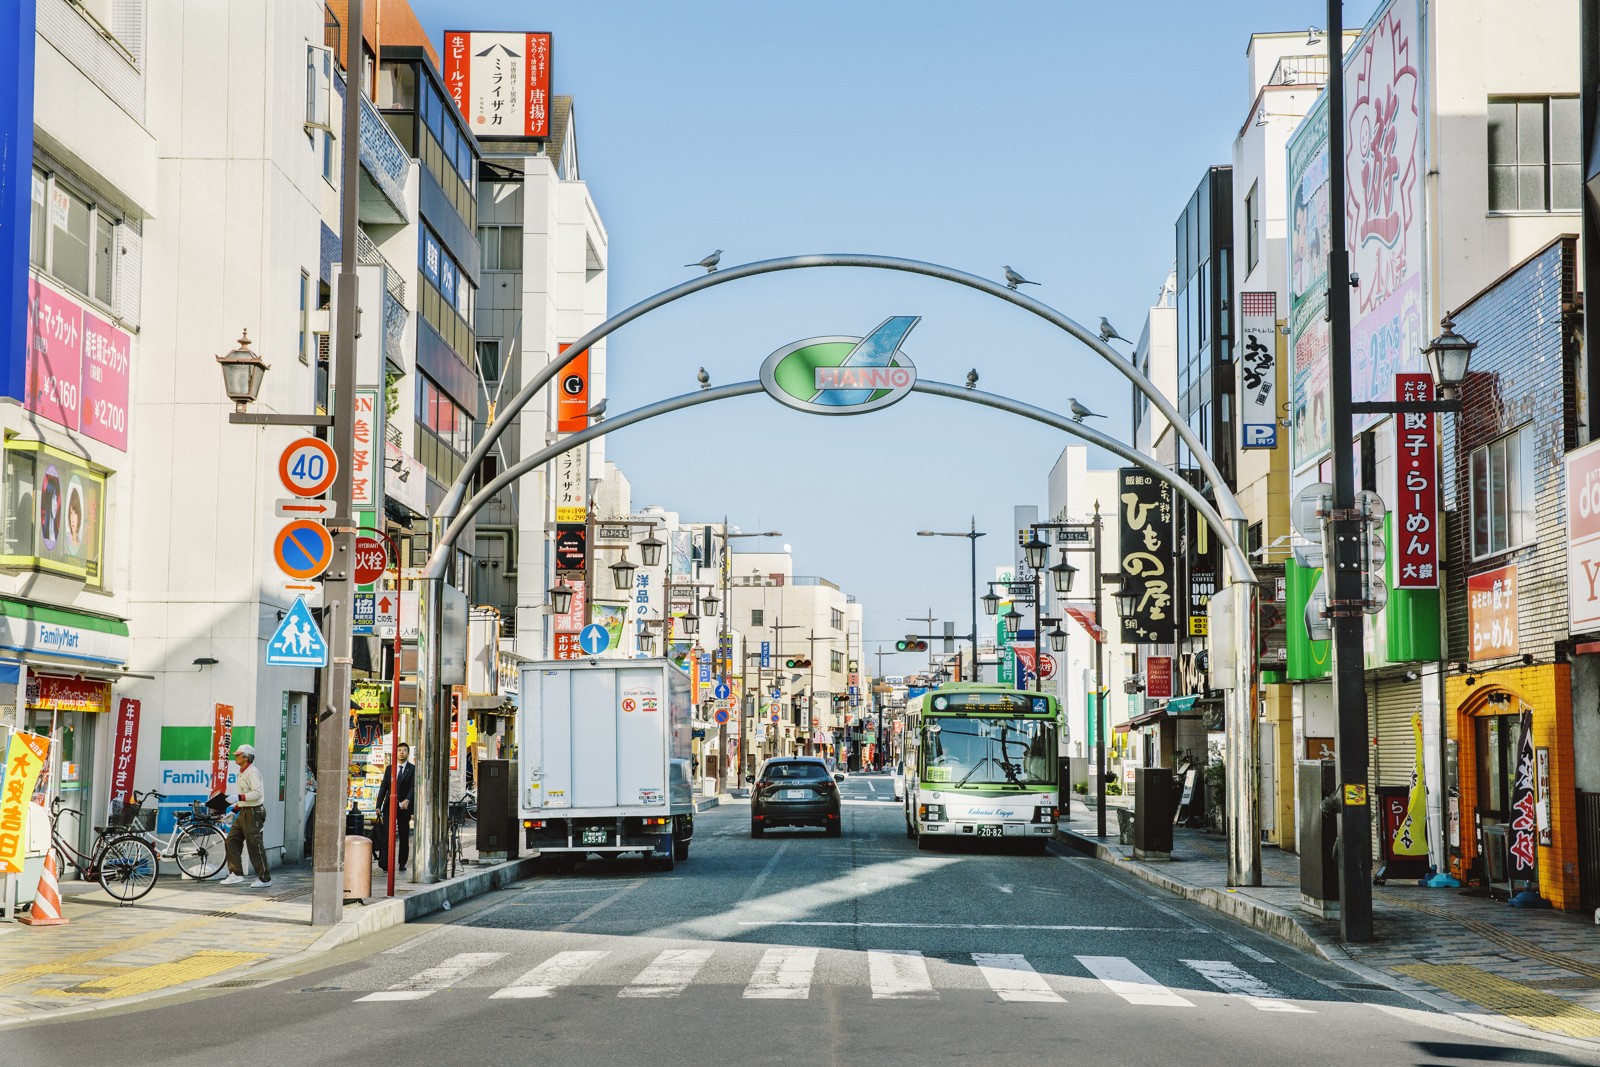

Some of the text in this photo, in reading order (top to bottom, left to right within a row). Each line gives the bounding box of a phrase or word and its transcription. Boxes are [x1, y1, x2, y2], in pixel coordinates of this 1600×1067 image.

[490, 58, 505, 126] ミライザカ
[530, 88, 545, 133] 唐揚げ
[1360, 83, 1400, 249] 遊
[565, 376, 581, 394] G
[820, 368, 910, 388] HANNO
[43, 375, 76, 412] ¥2,160
[94, 398, 124, 434] ¥2,700
[291, 454, 324, 481] 40
[355, 551, 384, 570] 火栓
[1121, 492, 1170, 621] ひもの屋
[1191, 594, 1213, 606] TO
[1192, 583, 1215, 594] DOU
[40, 625, 79, 650] FamilyMart
[1473, 621, 1513, 652] らーめん
[981, 828, 1002, 837] 20-82
